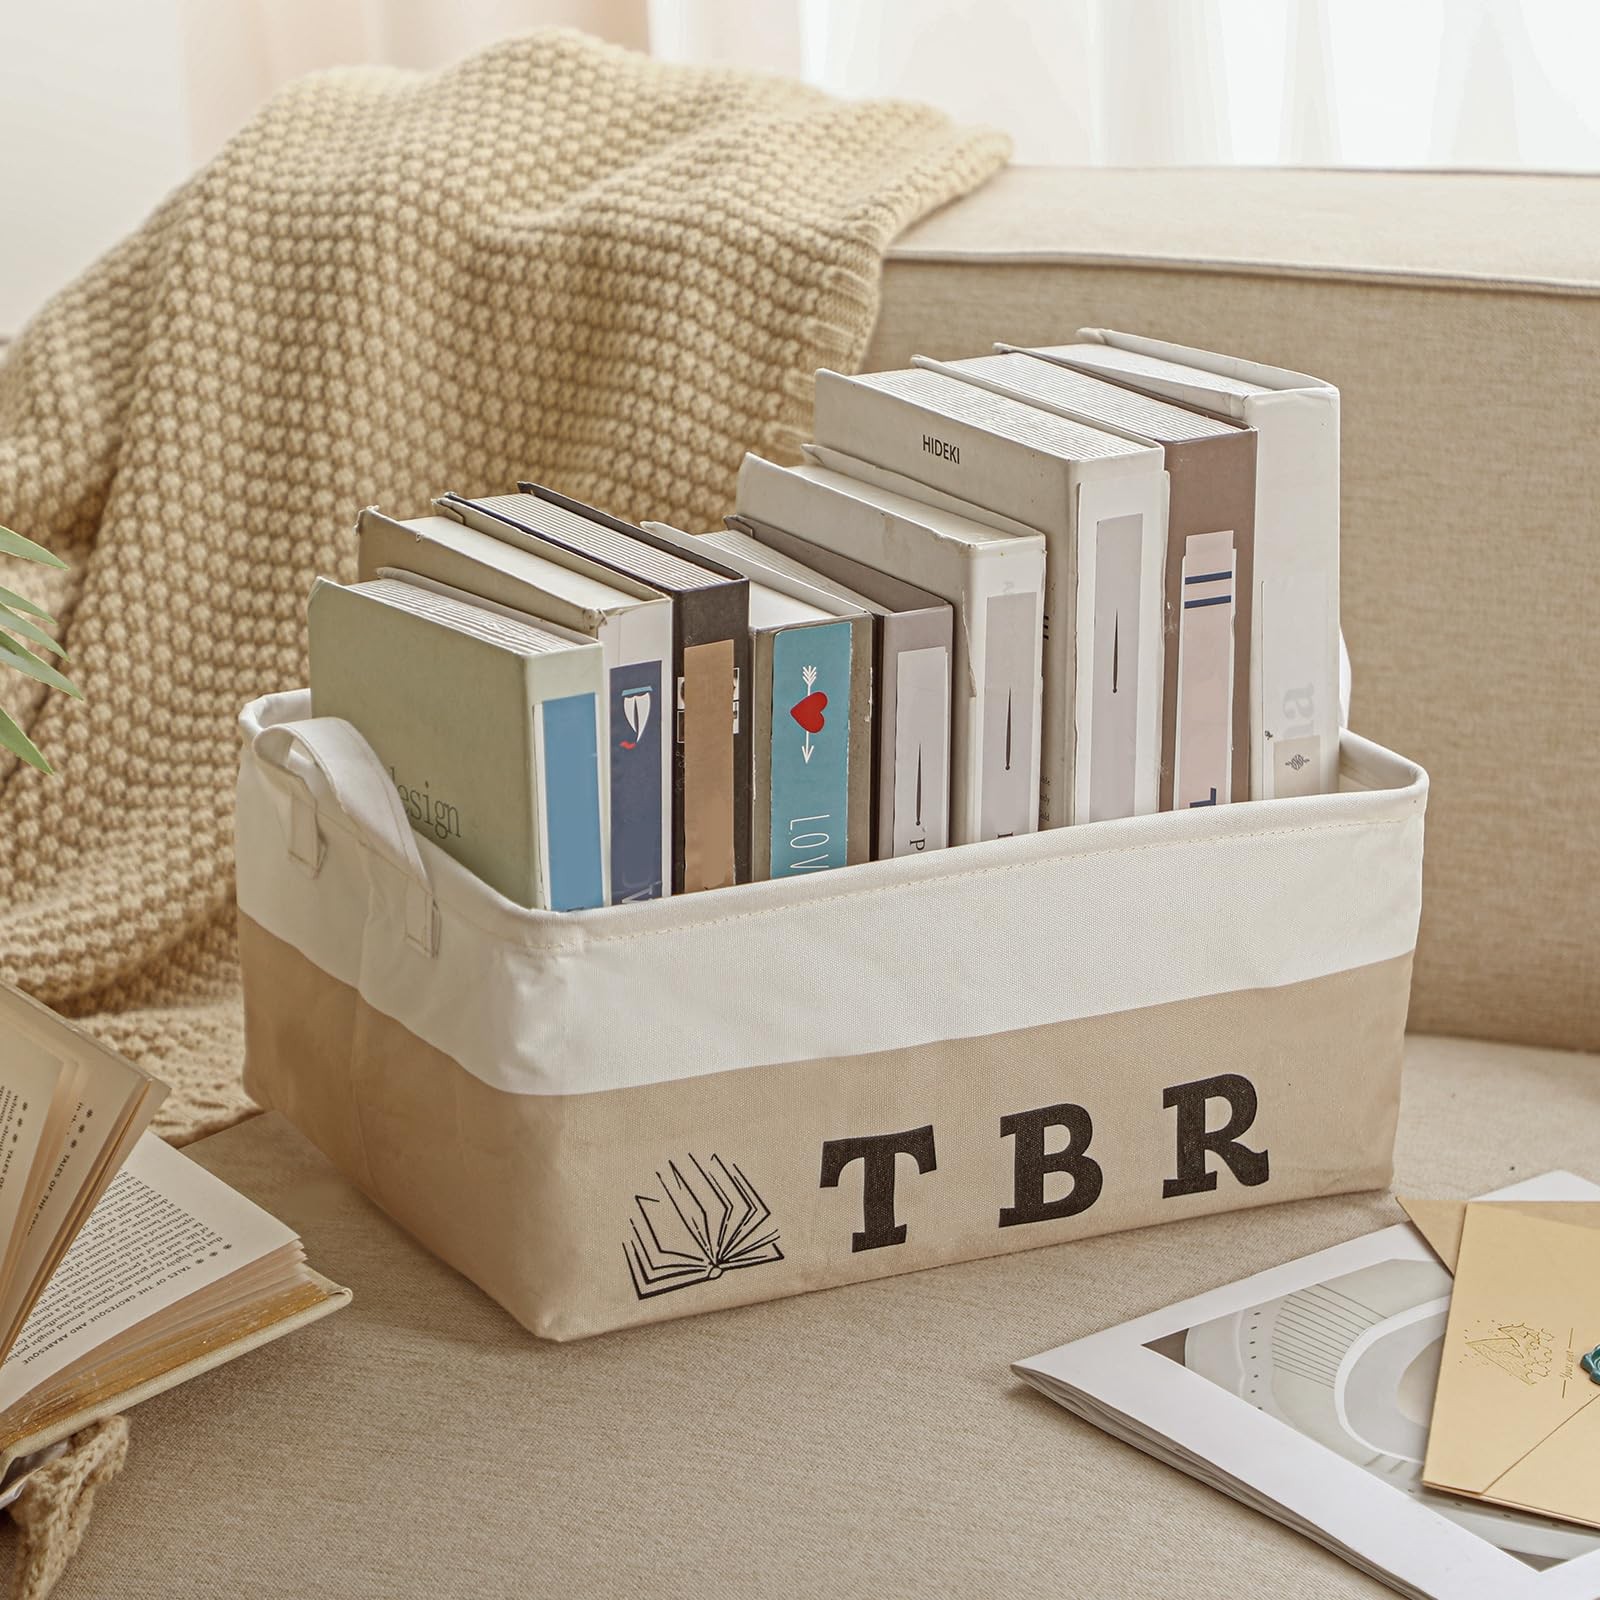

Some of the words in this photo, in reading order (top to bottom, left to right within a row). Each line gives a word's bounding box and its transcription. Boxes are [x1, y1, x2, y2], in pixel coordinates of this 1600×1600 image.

[922, 434, 960, 464] HIDEKI
[390, 766, 461, 839] esign
[54, 1154, 70, 1178] TALES
[820, 1125, 937, 1252] T
[999, 1102, 1104, 1228] B
[1162, 1073, 1269, 1199] R
[112, 1201, 133, 1214] with
[149, 1207, 167, 1218] this
[159, 1207, 182, 1221] since
[91, 1217, 116, 1233] might
[139, 1218, 162, 1231] been
[173, 1216, 195, 1230] upon
[89, 1231, 106, 1241] the
[155, 1227, 191, 1248] unaware
[204, 1235, 223, 1247] that
[165, 1240, 183, 1252] and
[183, 1238, 202, 1250] had
[191, 1244, 206, 1254] the
[117, 1250, 132, 1260] the
[126, 1252, 145, 1263] any
[148, 1249, 167, 1260] that
[160, 1247, 185, 1261] taken
[163, 1252, 193, 1268] highly
[112, 1261, 142, 1279] person
[147, 1259, 163, 1268] for
[166, 1264, 192, 1279] TALES
[91, 1277, 115, 1291] born
[135, 1284, 154, 1296] THE
[60, 1295, 82, 1309] such
[87, 1293, 137, 1323] GROTESQUE
[55, 1310, 86, 1330] around
[68, 1321, 89, 1335] AND
[30, 1328, 56, 1346] might
[21, 1333, 70, 1365] ARABESQUE
